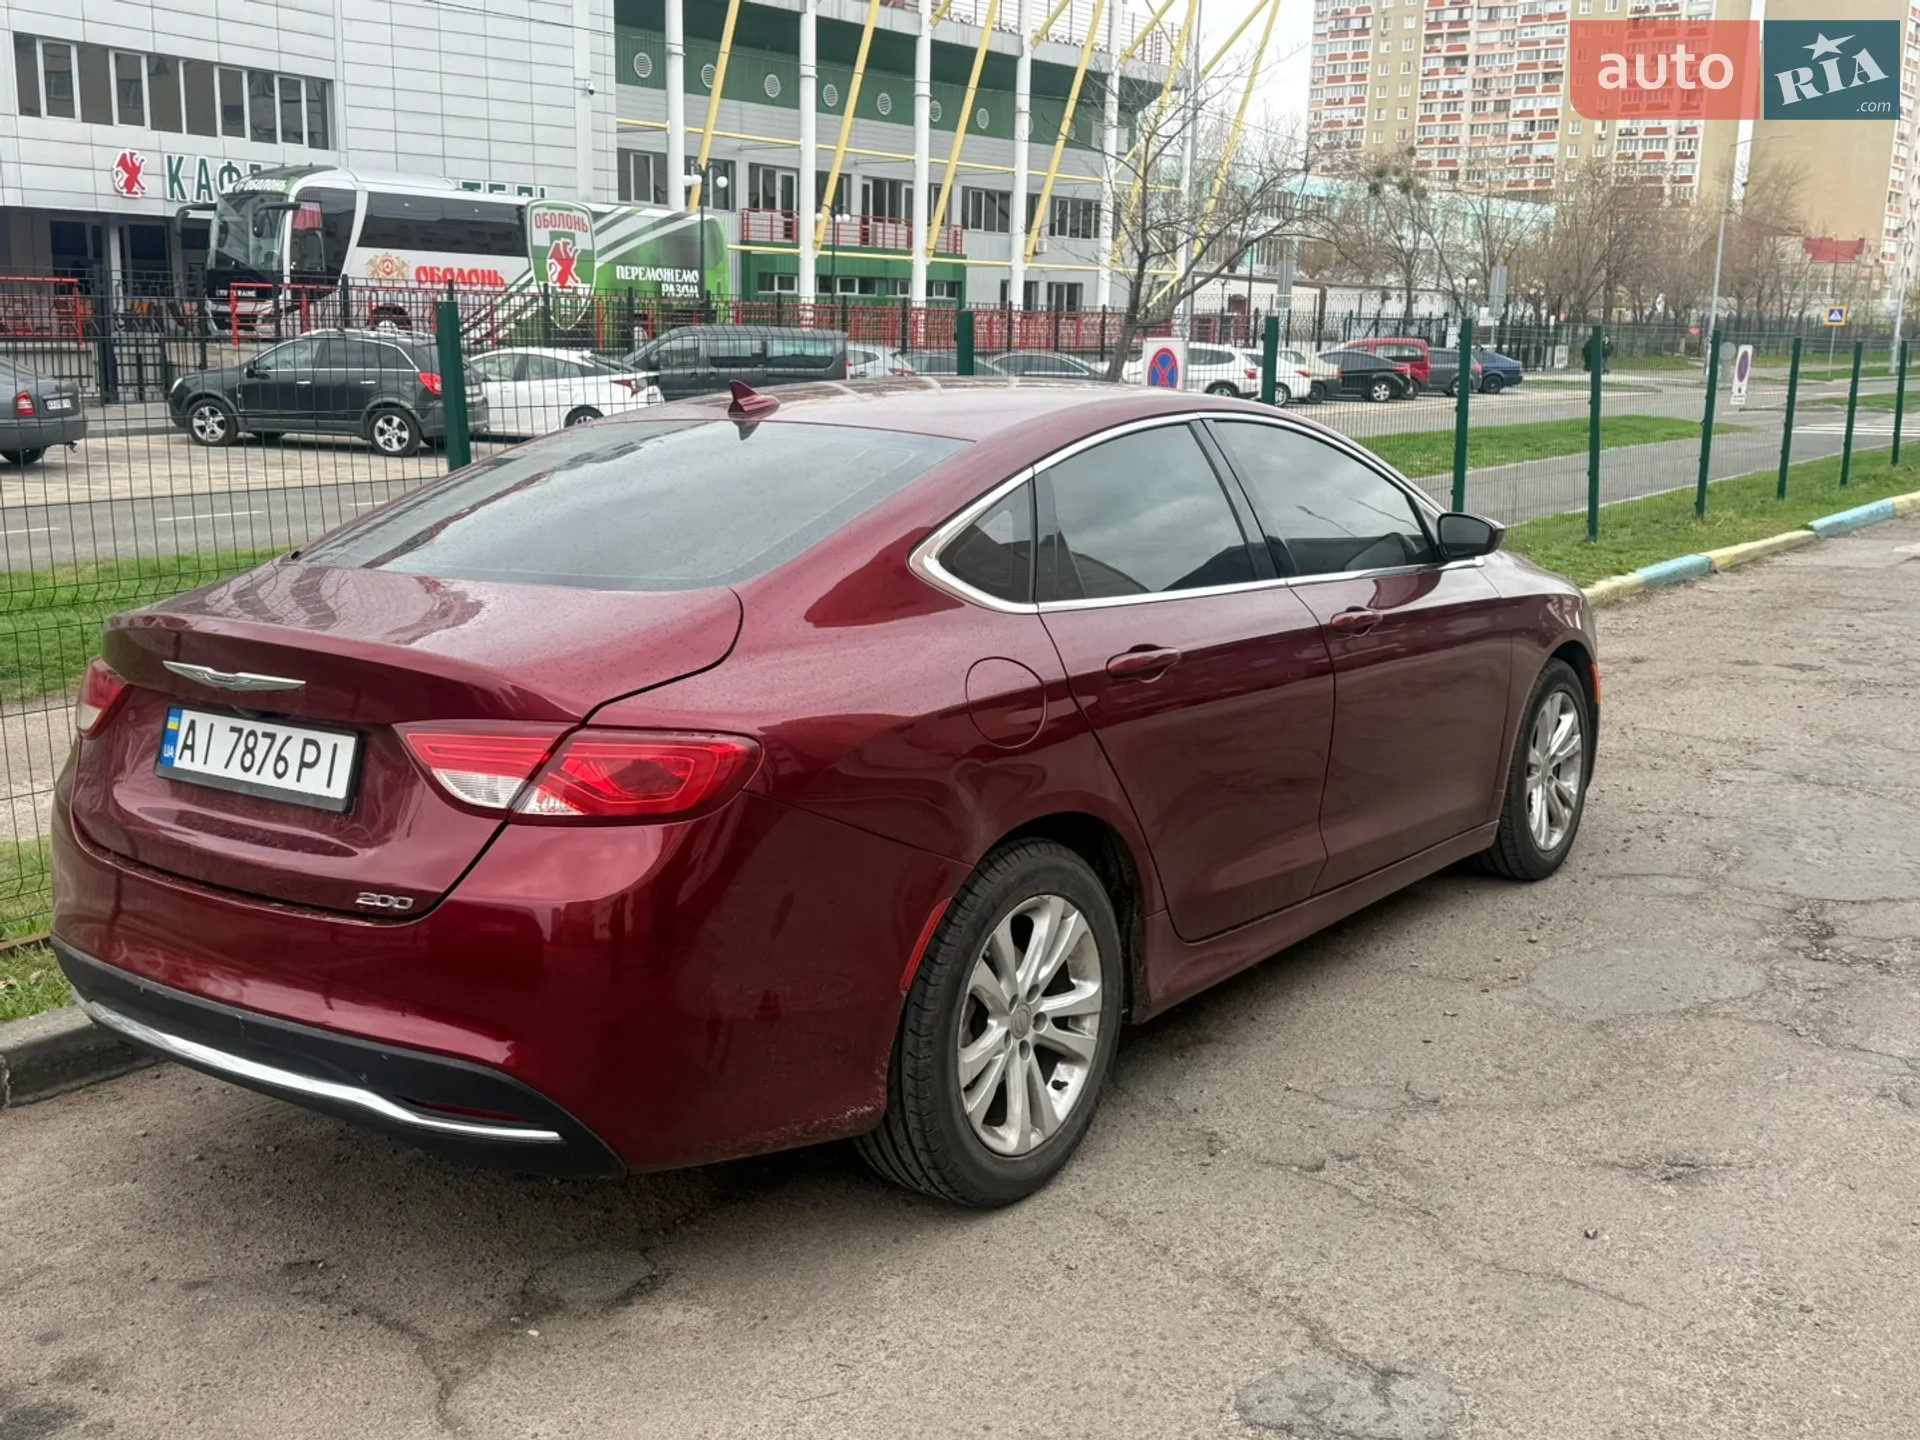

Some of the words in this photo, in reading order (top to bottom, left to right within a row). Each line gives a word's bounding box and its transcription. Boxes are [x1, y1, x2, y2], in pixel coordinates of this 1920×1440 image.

[164, 154, 262, 203] КАФ
[534, 212, 589, 233] ОБОЛОНЬ
[415, 265, 505, 288] ОБОЛОНЬ
[615, 265, 700, 283] ПЕРЕМОЖЕМО
[661, 283, 700, 298] РАЗОМ
[163, 745, 175, 759] UA
[224, 725, 293, 780] 7876
[355, 892, 414, 909] 200
